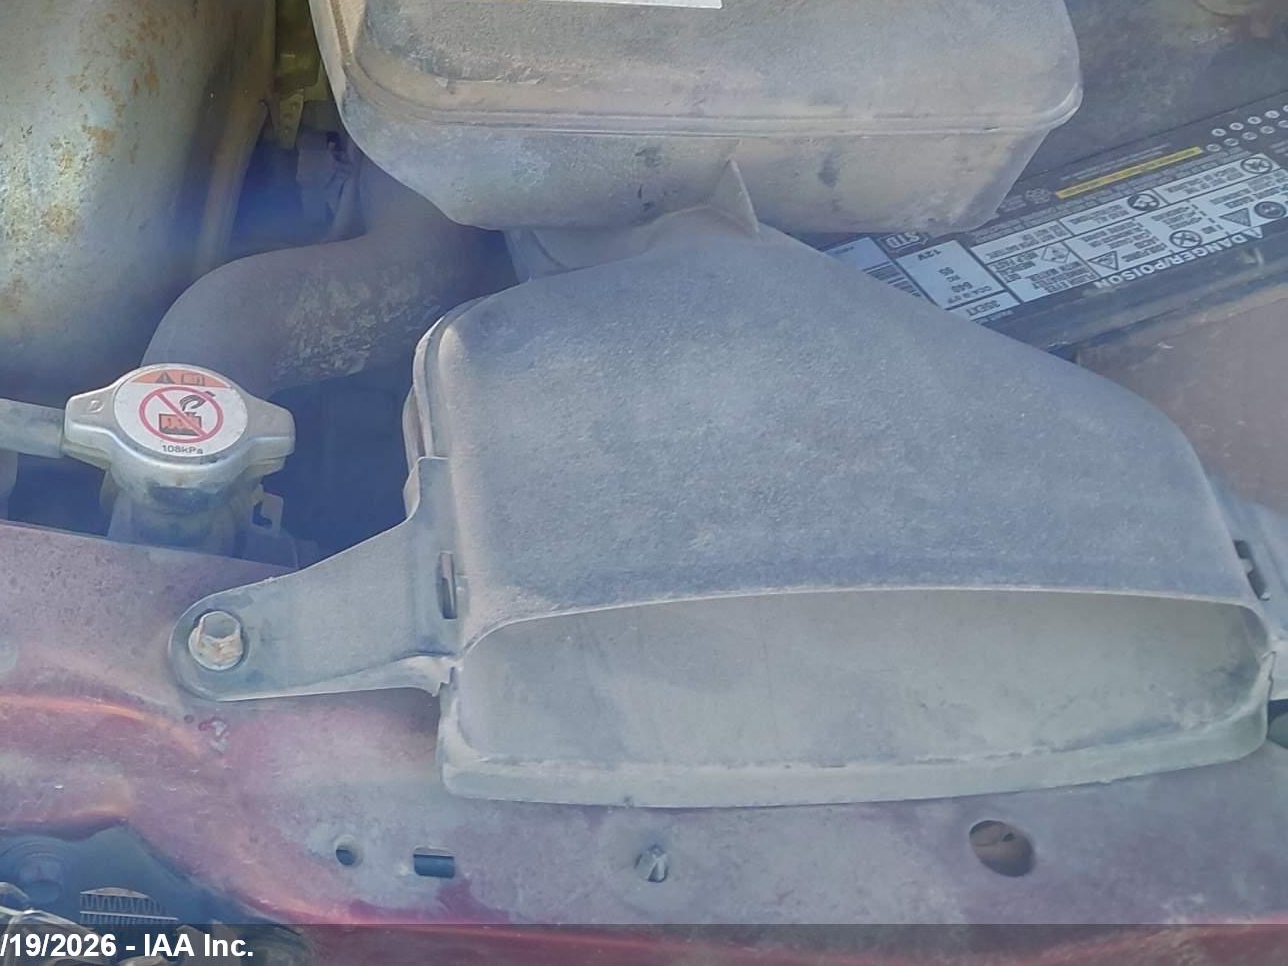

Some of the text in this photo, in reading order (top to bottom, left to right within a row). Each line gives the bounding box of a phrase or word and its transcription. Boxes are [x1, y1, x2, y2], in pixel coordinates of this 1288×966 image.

[918, 250, 941, 260] 12V
[1093, 233, 1247, 288] DANGER/POISON
[161, 444, 204, 454] 108kPa
